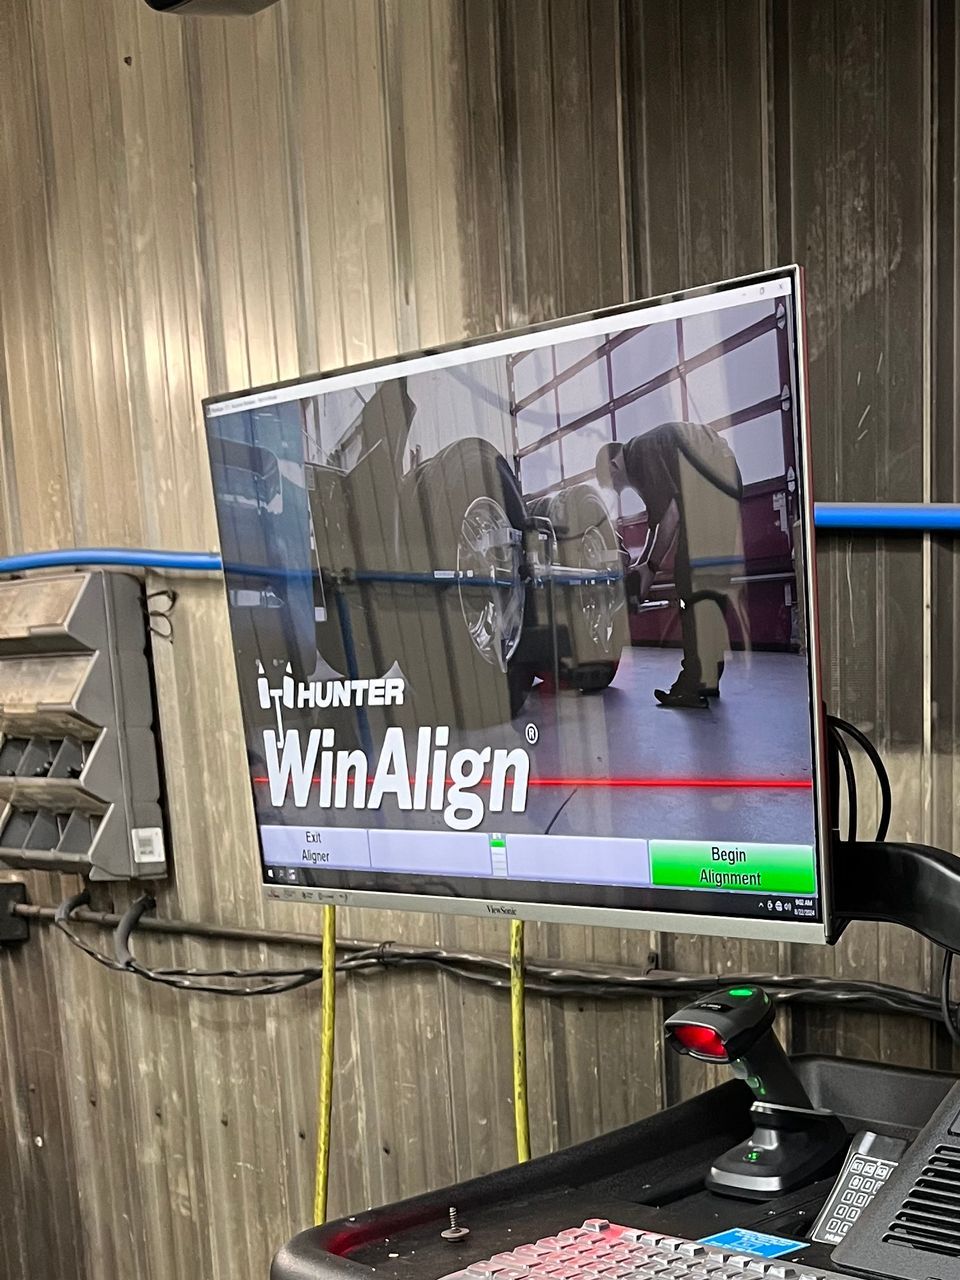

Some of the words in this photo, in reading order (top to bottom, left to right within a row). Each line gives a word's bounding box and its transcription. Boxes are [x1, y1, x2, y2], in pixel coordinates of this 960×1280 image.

[297, 678, 404, 708] HUNTER
[305, 831, 322, 843] Exit
[302, 849, 330, 864] Aligner
[711, 846, 747, 865] Begin
[700, 868, 762, 887] Alignment
